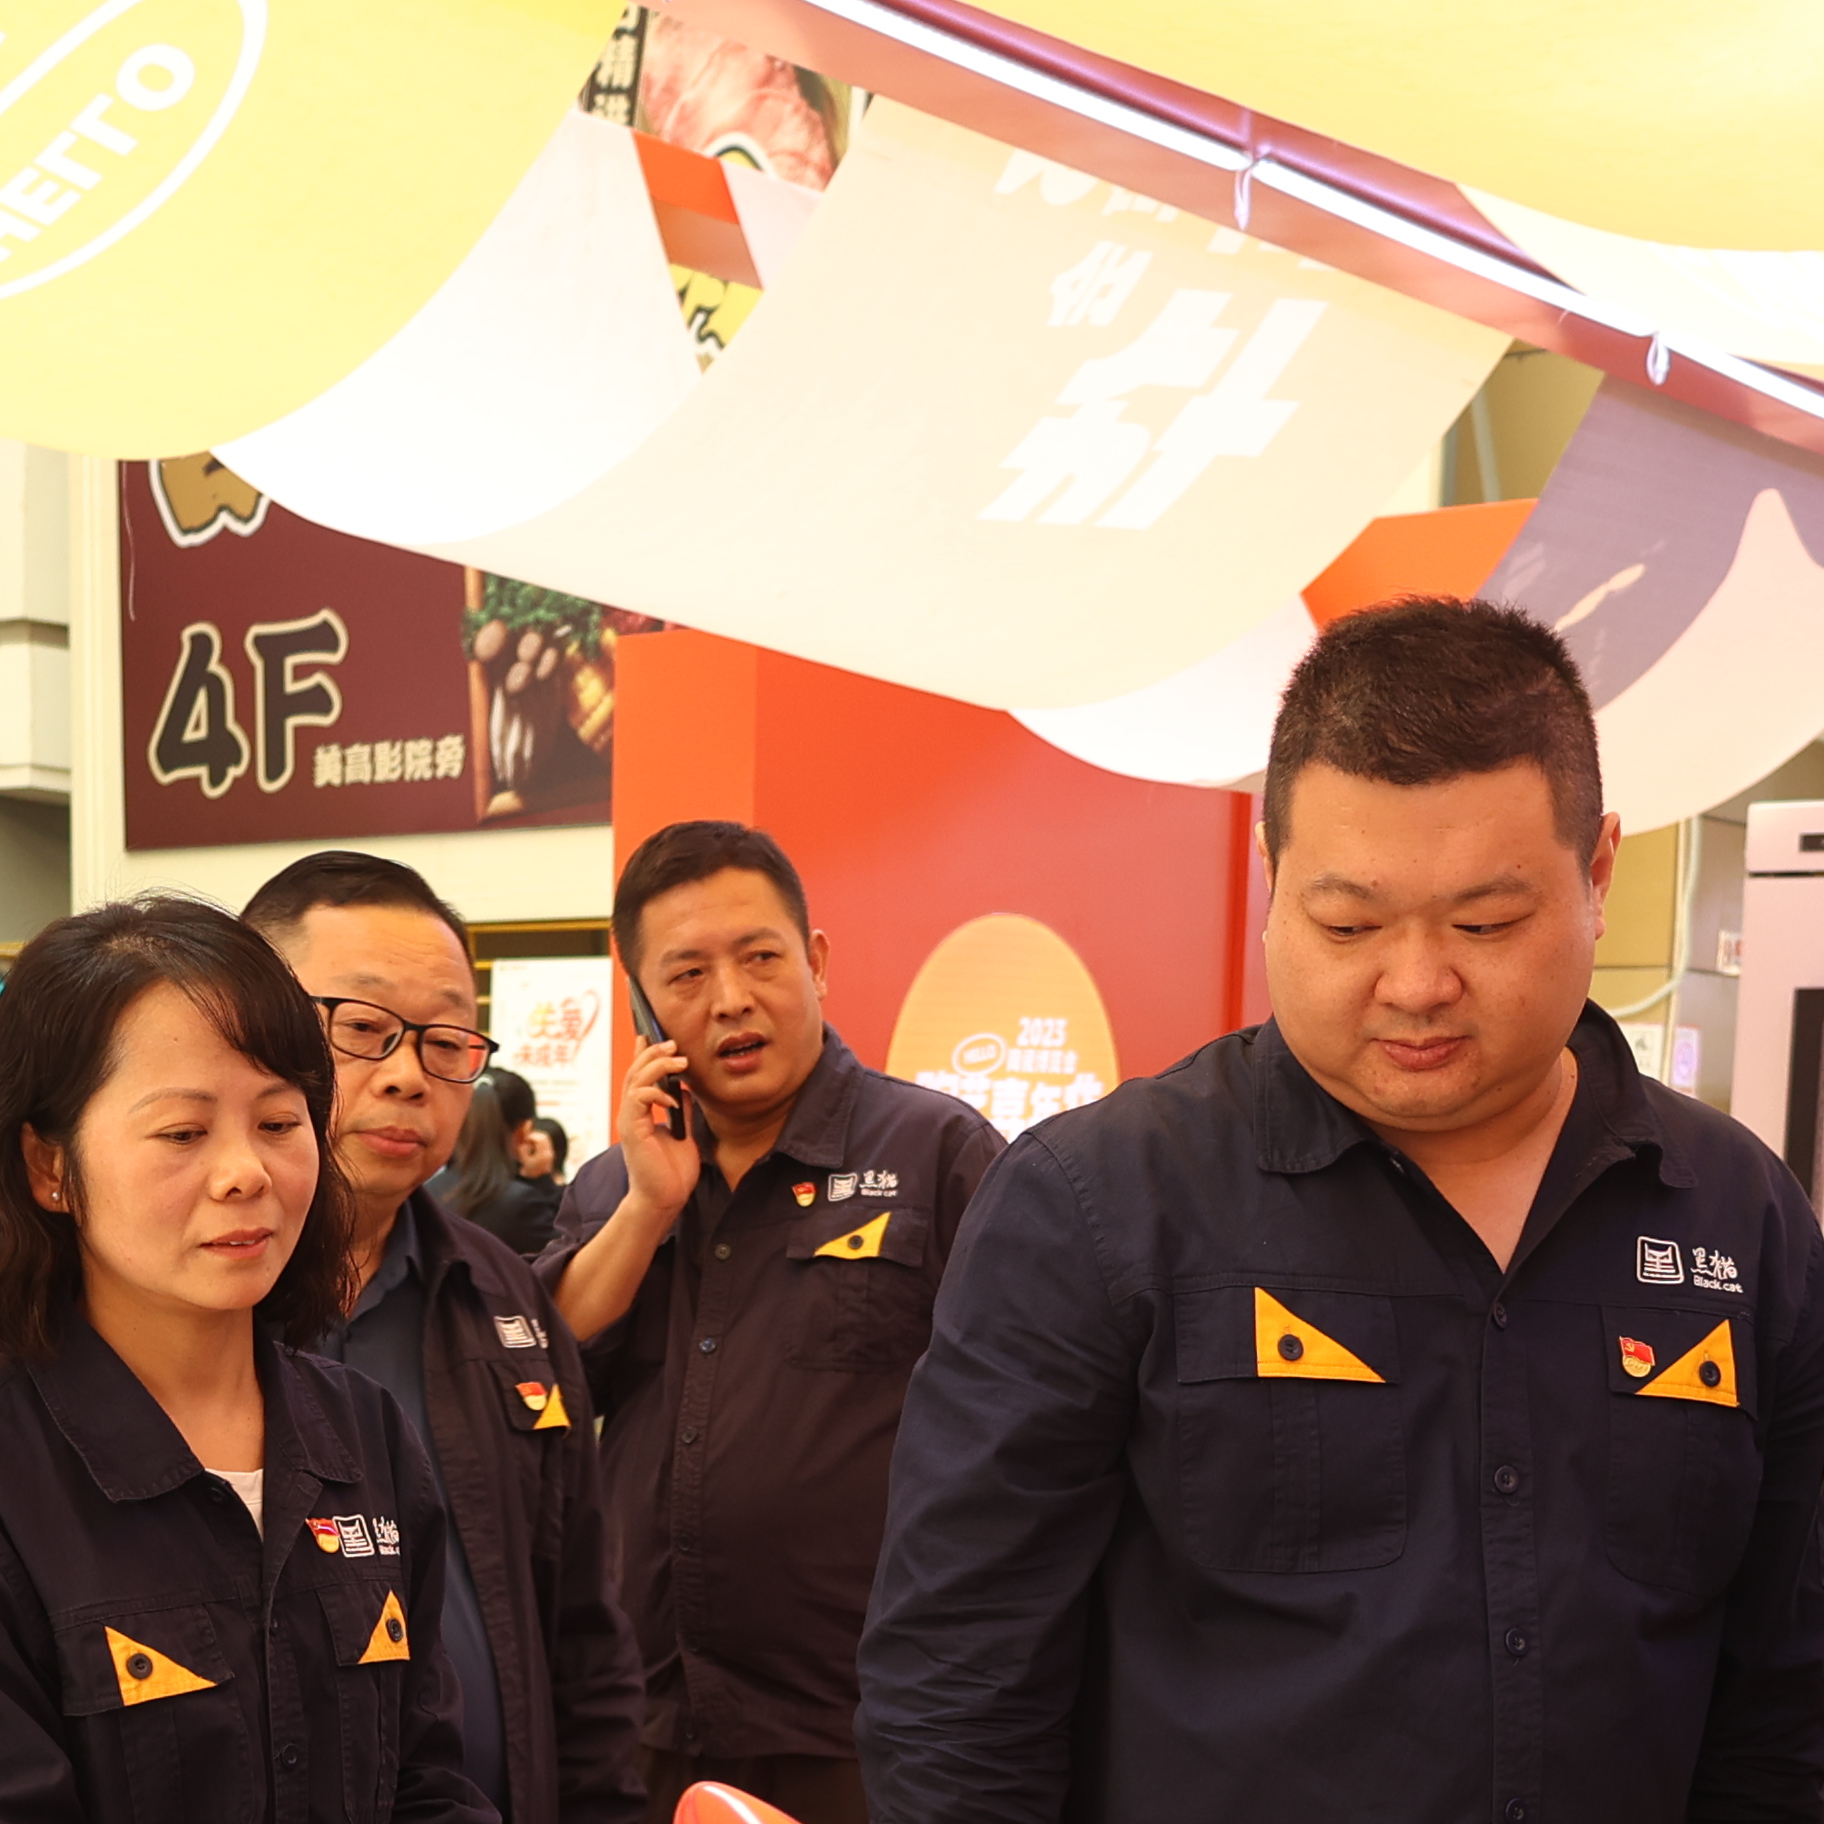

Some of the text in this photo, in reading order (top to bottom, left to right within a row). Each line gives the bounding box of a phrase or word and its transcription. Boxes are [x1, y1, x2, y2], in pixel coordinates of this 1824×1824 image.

[148, 608, 350, 799] 4F
[1016, 1016, 1069, 1048] 2023
[1690, 1246, 1738, 1281] 黑猫
